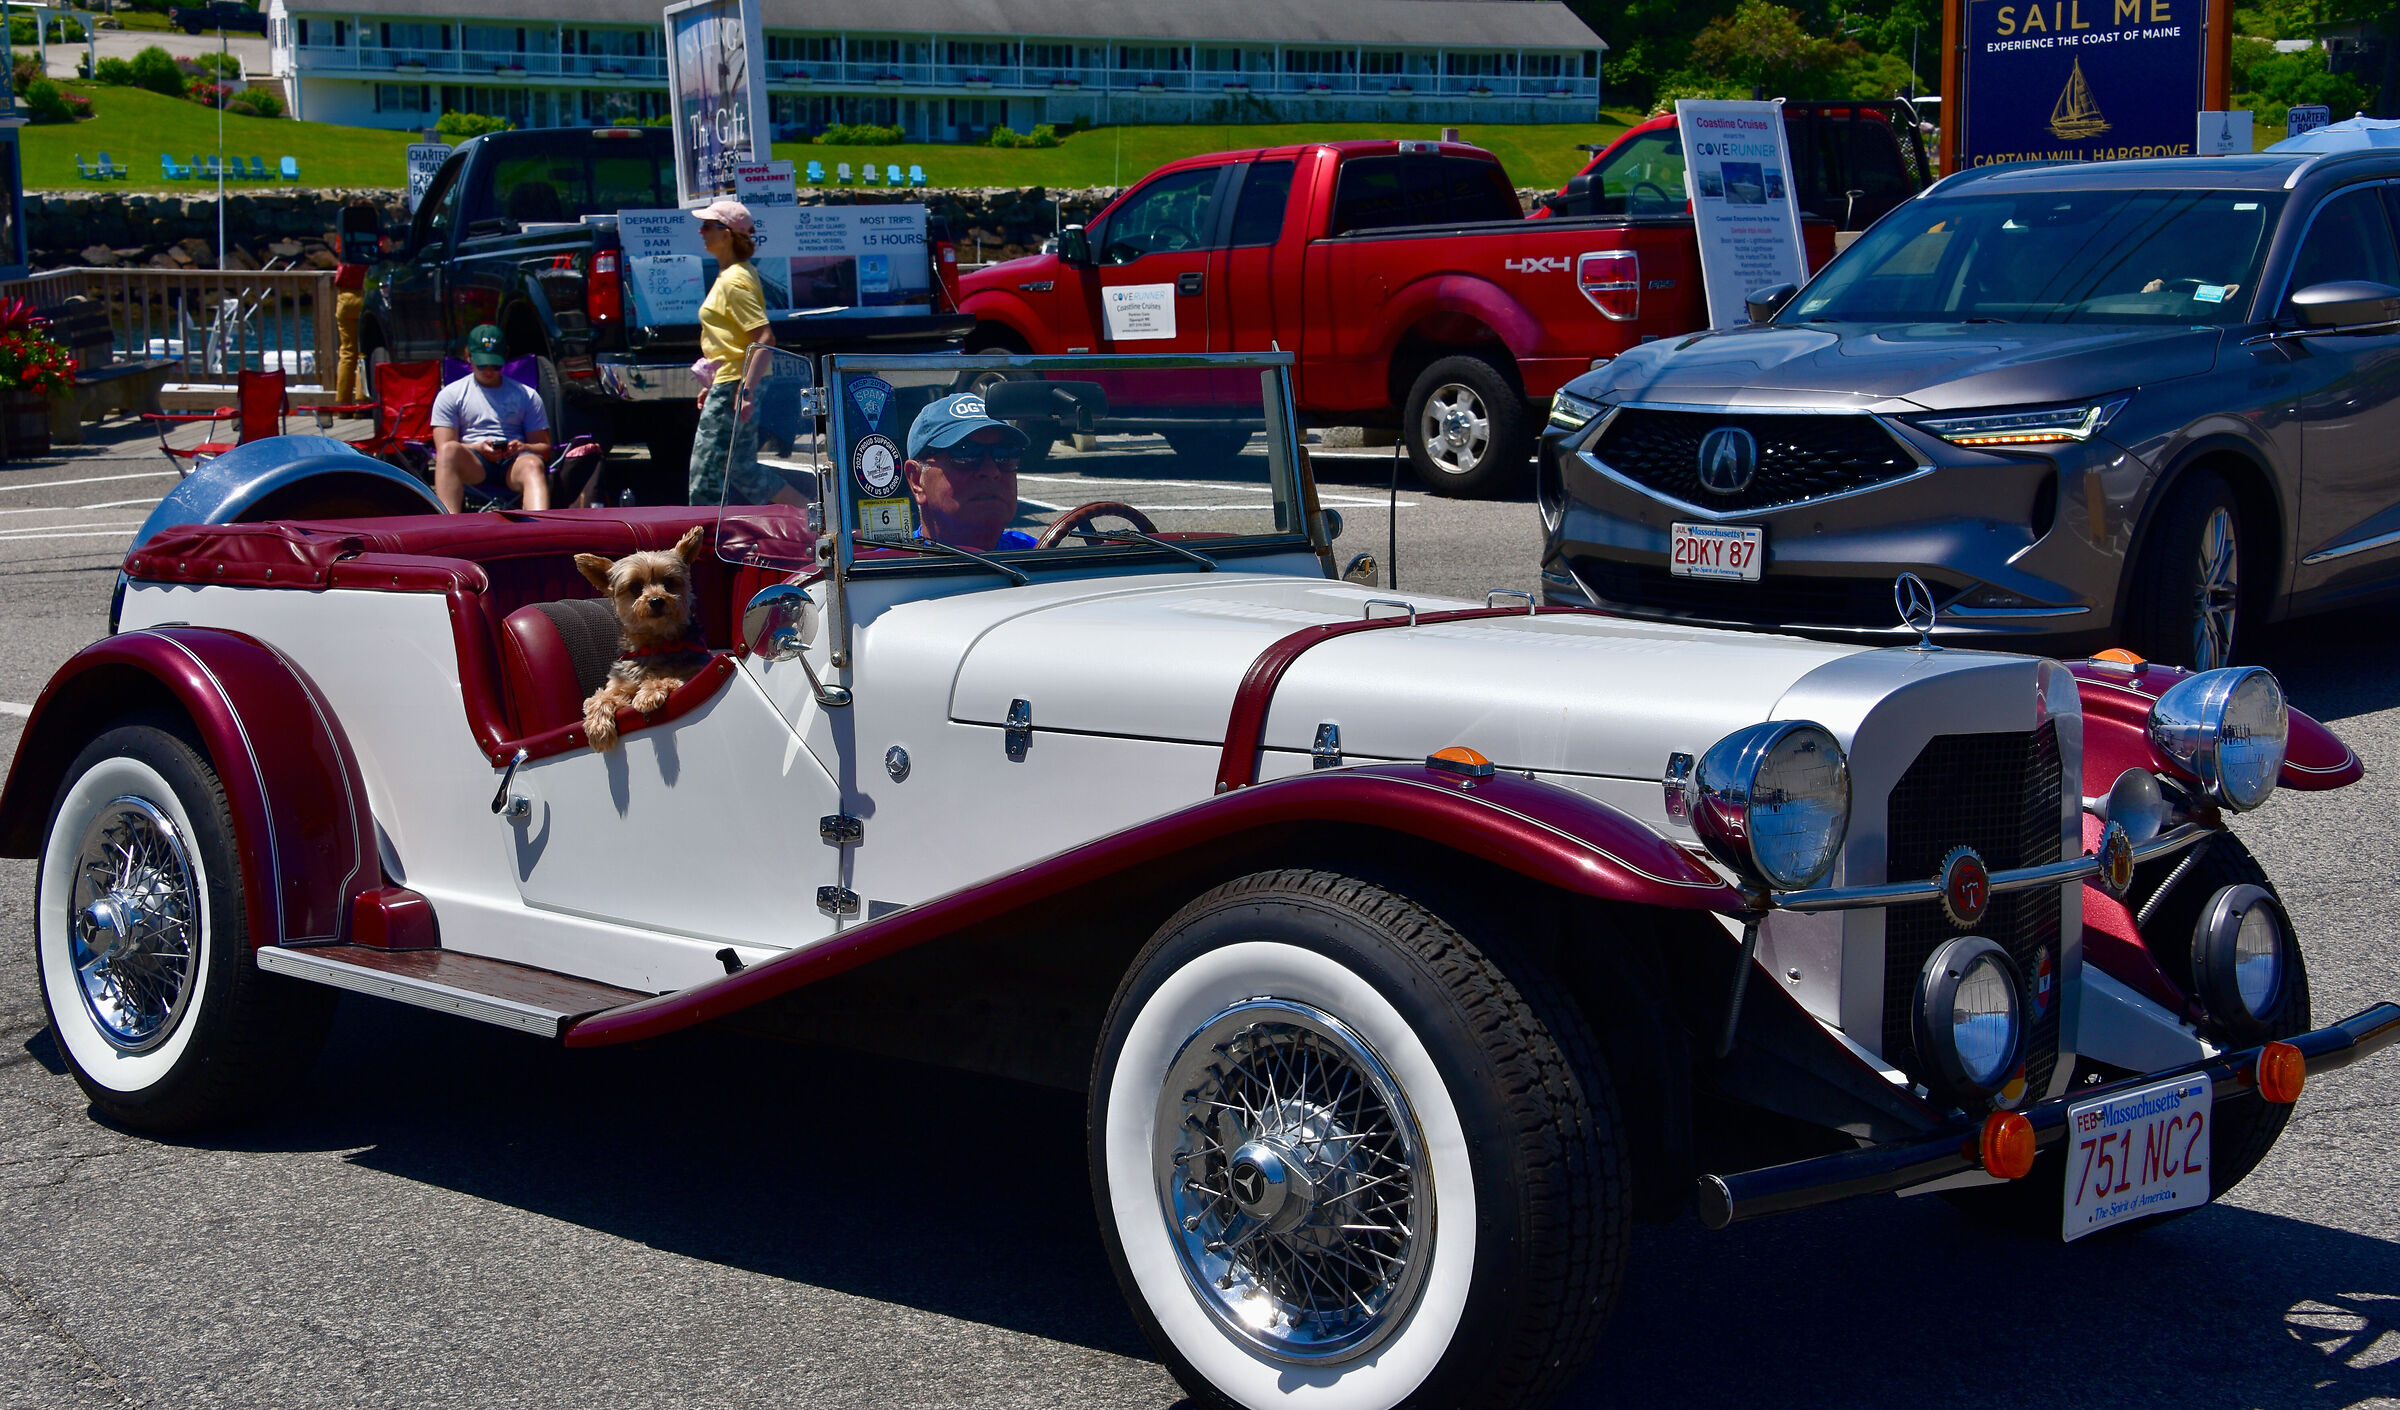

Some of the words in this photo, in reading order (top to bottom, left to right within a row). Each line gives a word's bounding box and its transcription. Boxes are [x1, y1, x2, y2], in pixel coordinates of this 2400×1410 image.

[1996, 0, 2090, 36] SAIL
[2113, 0, 2172, 26] ME
[1987, 37, 2054, 52] EXPERIENCE
[2057, 35, 2079, 46] THE
[2082, 31, 2120, 45] COAST
[2123, 29, 2140, 41] OF
[2142, 26, 2181, 39] MAINE
[1696, 117, 1736, 129] Coastline
[1736, 118, 1768, 130] Cruises
[2290, 112, 2326, 123] CHARTER
[690, 110, 709, 150] The
[715, 102, 745, 151] Gift
[738, 166, 769, 175] BOOK
[744, 174, 790, 183] ONLINE!
[625, 215, 685, 225] DEPARTURE
[860, 216, 885, 225] MOST
[888, 216, 914, 224] TRIPS:
[640, 226, 672, 234] TIMES:
[644, 239, 651, 247] 9
[652, 238, 670, 247] AM
[863, 234, 878, 246] 1.5
[881, 233, 923, 245] HOURS
[1504, 256, 1571, 273] 4X4
[1116, 303, 1141, 313] Coastline
[1141, 302, 1161, 311] Cruises
[852, 379, 868, 390] MSP
[870, 379, 886, 390] 2019
[855, 389, 885, 402] SPAM
[858, 437, 874, 453] PROUD
[873, 436, 899, 460] SUPPORTER
[855, 452, 863, 470] 2023
[864, 482, 875, 493] LET
[874, 488, 882, 496] US
[882, 487, 890, 495] DO
[889, 475, 900, 490] GOOD
[881, 510, 890, 525] 6
[1675, 525, 1687, 534] JUL
[1690, 525, 1741, 539] Massachusetts
[1674, 536, 1723, 567] 2DKY
[1729, 539, 1756, 568] 87
[2077, 1111, 2098, 1134] FEB
[2102, 1091, 2181, 1129] Massachusetts
[2075, 1128, 2132, 1207] 751
[2141, 1110, 2204, 1187] NC2
[2094, 1206, 2109, 1222] The
[2110, 1200, 2129, 1218] Spirit
[2129, 1197, 2139, 1212] of
[2139, 1188, 2171, 1207] America
